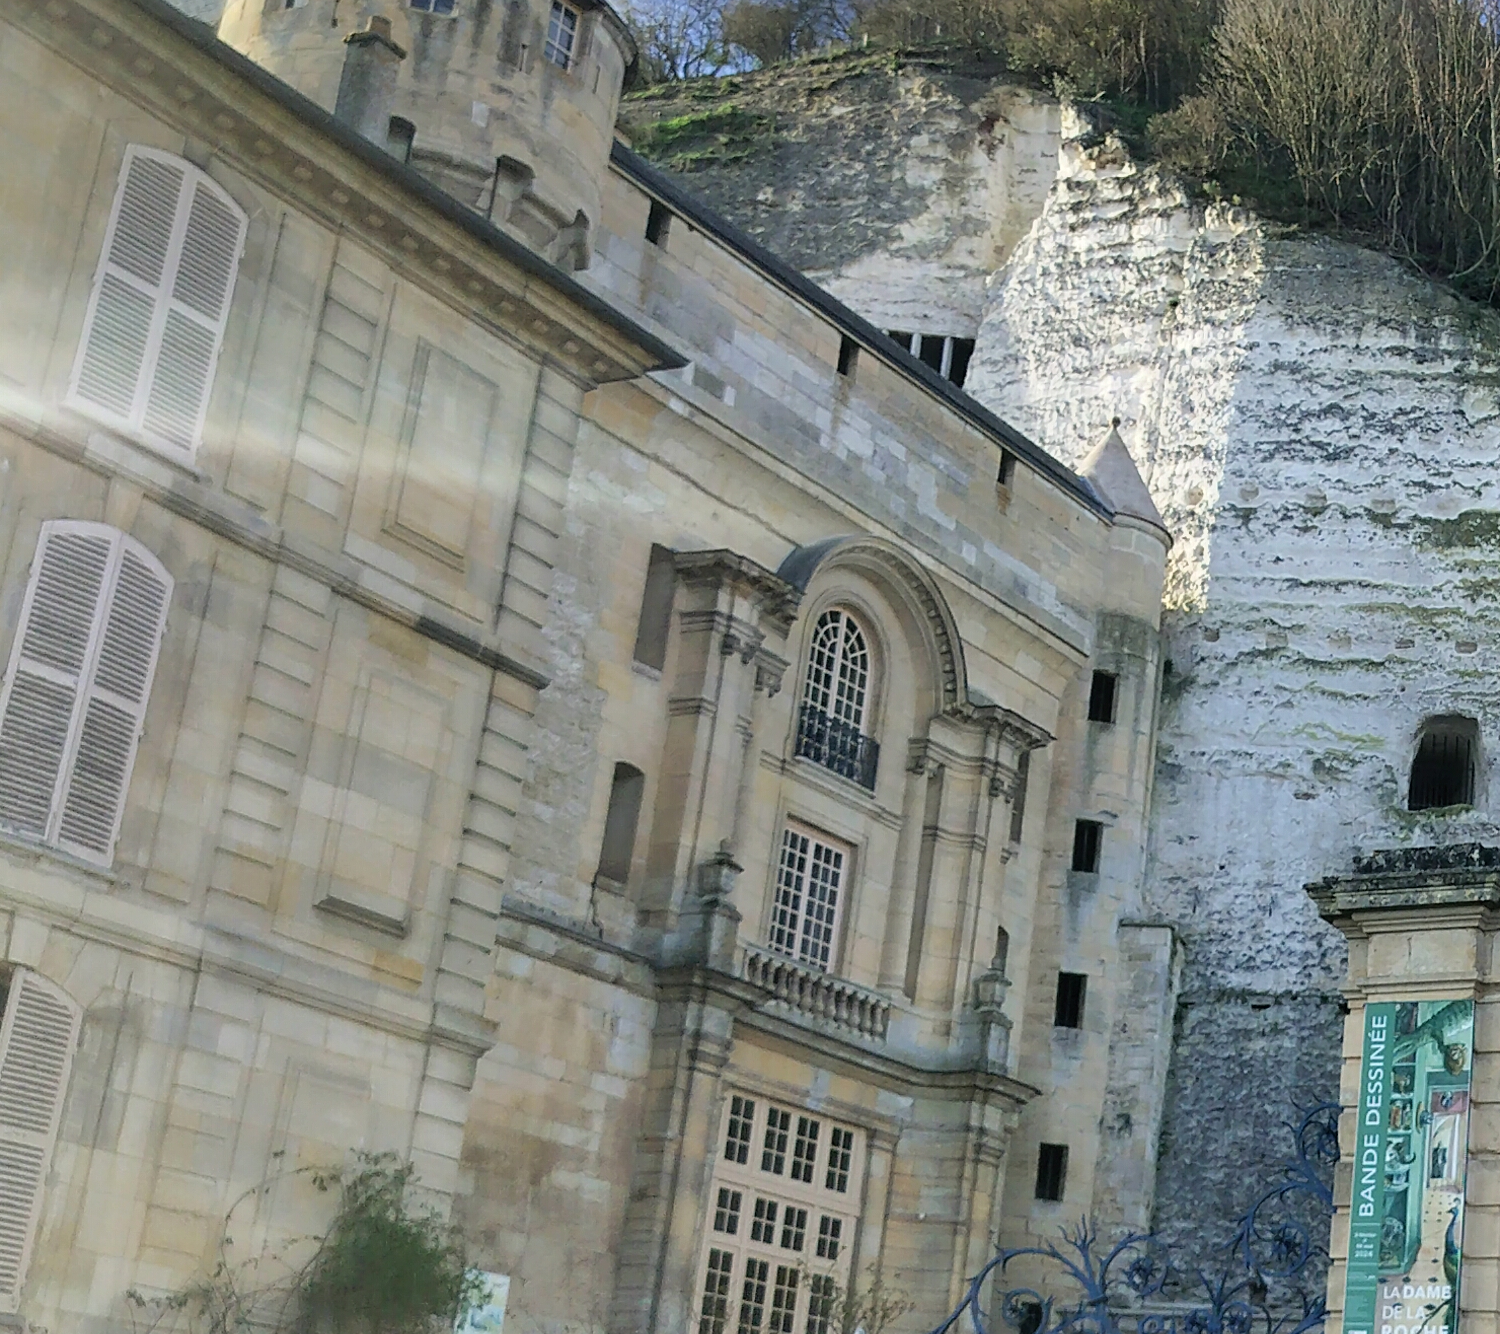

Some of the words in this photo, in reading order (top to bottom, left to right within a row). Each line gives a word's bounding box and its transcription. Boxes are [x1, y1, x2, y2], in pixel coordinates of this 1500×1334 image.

[1365, 1015, 1387, 1126] DESSINÉE
[1359, 1133, 1379, 1217] BANDE
[1382, 1306, 1402, 1320] DE
[1406, 1306, 1426, 1320] LA
[1383, 1285, 1400, 1299] LA
[1403, 1284, 1452, 1300] DAME
